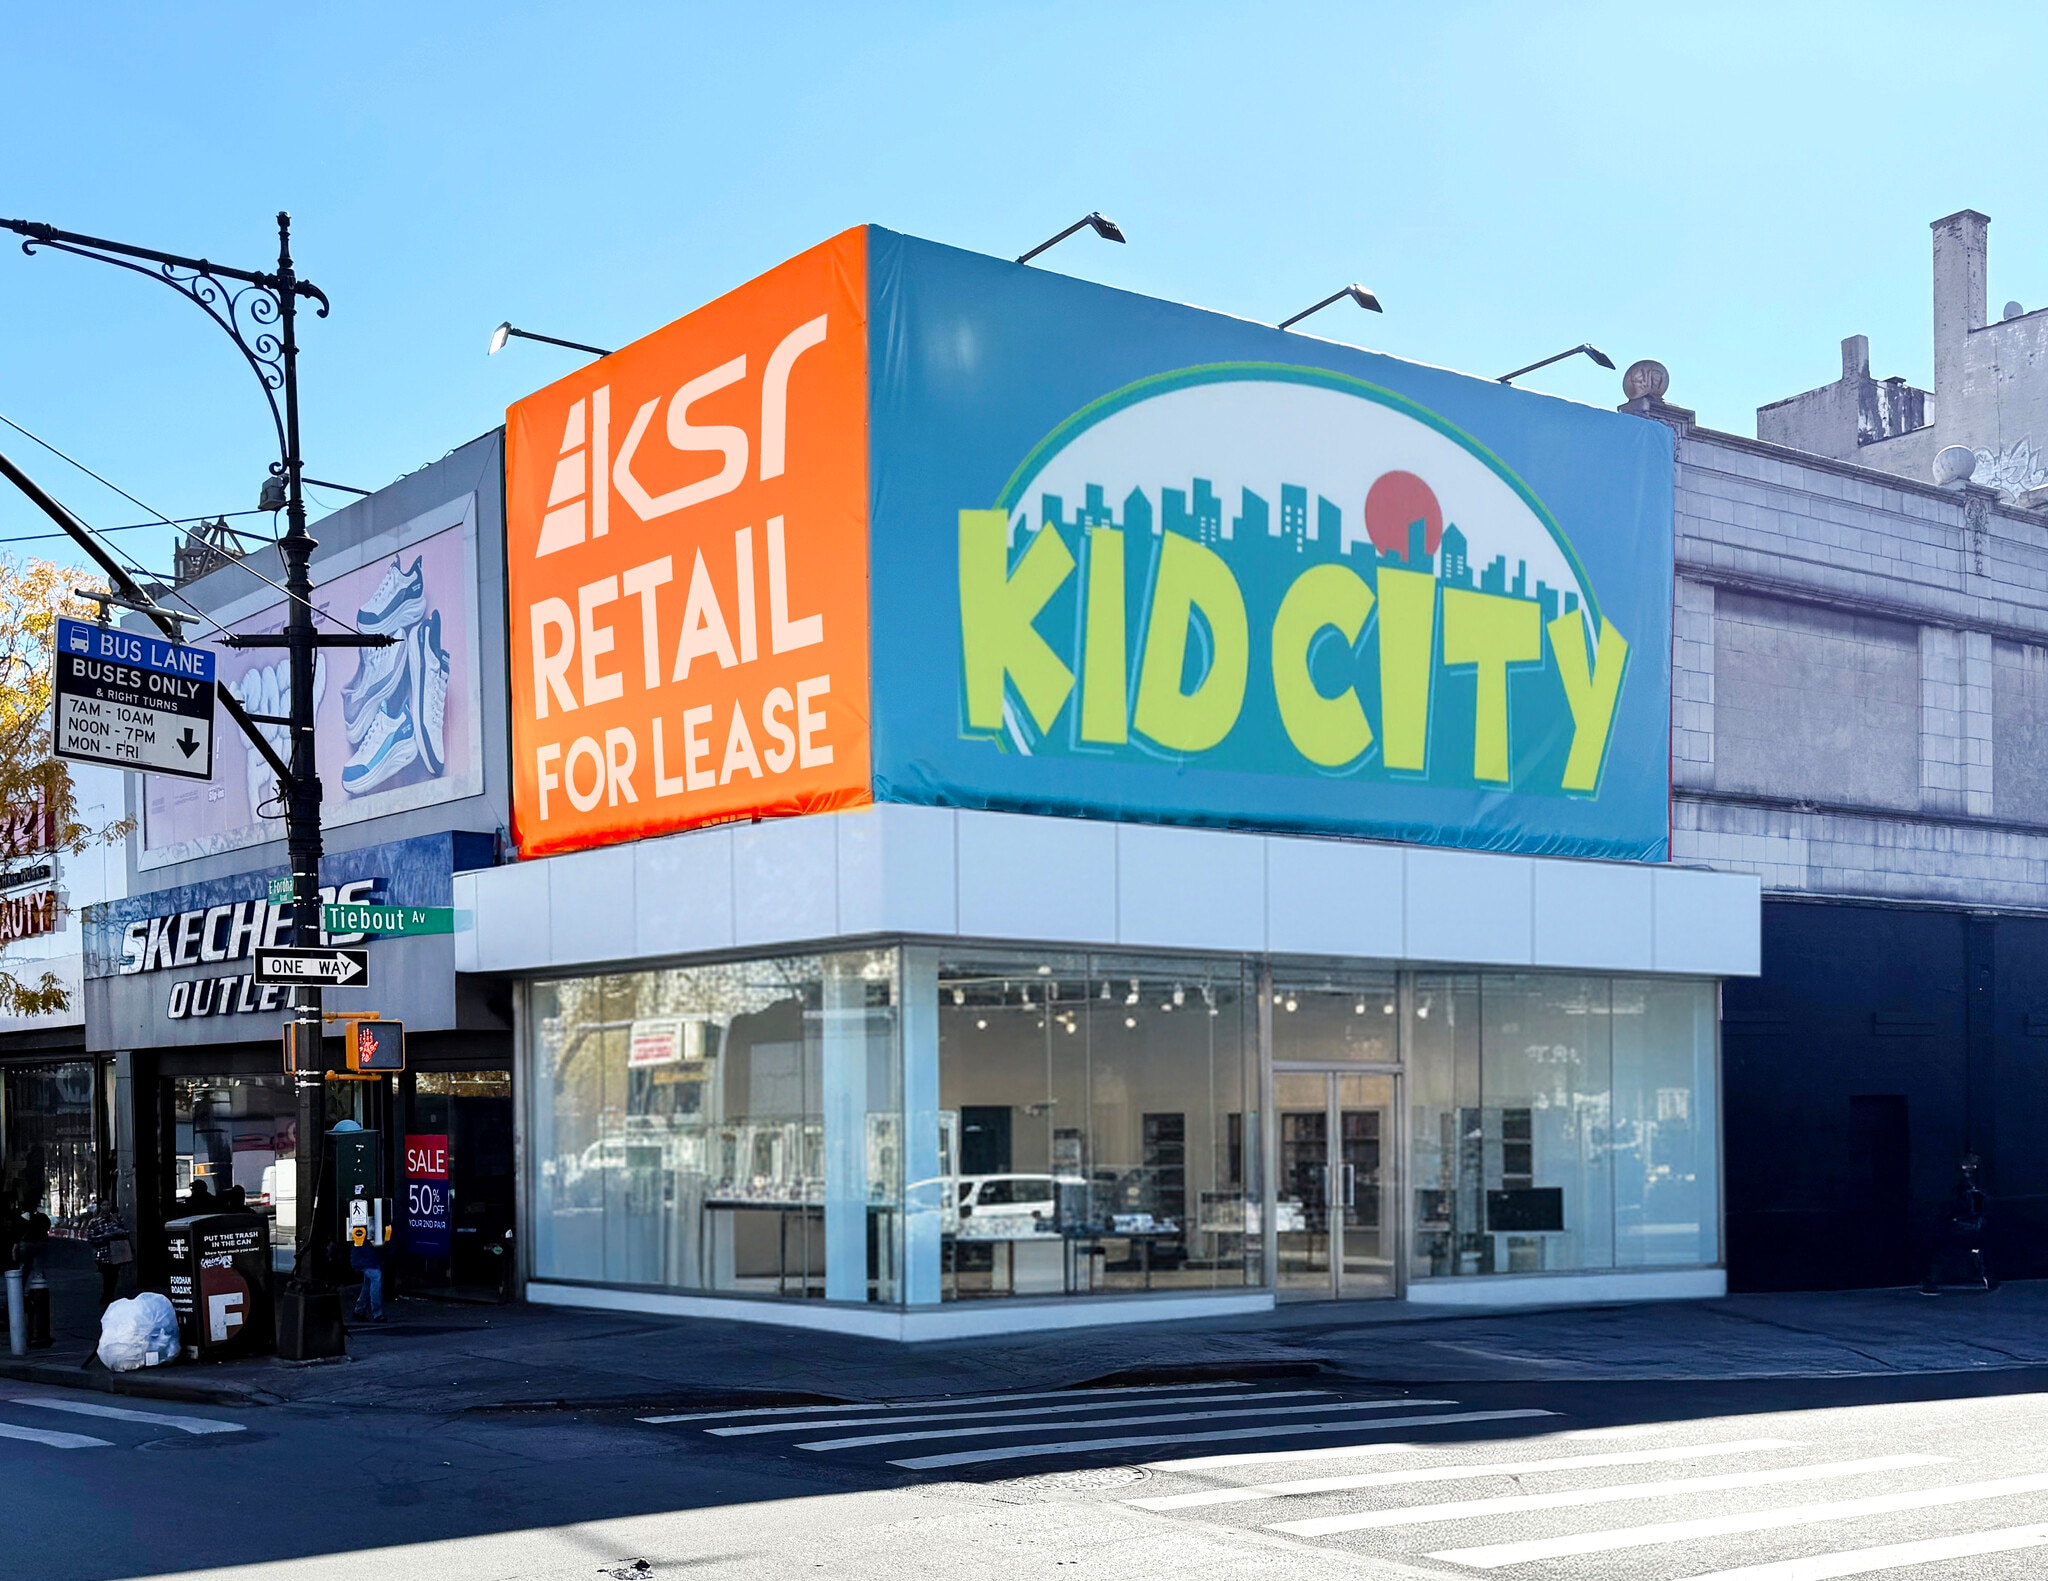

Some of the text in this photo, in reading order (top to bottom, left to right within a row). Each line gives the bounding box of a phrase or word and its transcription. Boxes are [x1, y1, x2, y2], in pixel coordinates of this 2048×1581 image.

[530, 515, 824, 720] RETAIL
[100, 634, 205, 676] BUS LANE
[957, 509, 1630, 795] KID CITY
[72, 658, 200, 700] BUSES ONLY
[70, 699, 100, 717] 7AM
[117, 708, 154, 726] 10AM
[96, 688, 178, 712] & RIGHT TURNS
[68, 717, 109, 736] NOON
[124, 727, 156, 744] 7PM
[68, 735, 100, 753] MON
[116, 743, 139, 759] FRI
[537, 674, 834, 821] FOR LEASE
[273, 877, 294, 894] Fordha
[119, 877, 376, 975] SKECHES
[329, 906, 426, 931] Tiebout Av
[271, 959, 351, 976] ONE WAY
[167, 974, 297, 1019] OUTLE
[408, 1149, 445, 1173] SALE
[432, 1205, 445, 1215] OFF
[235, 1231, 259, 1239] TRASH
[408, 1219, 422, 1227] YOUR
[423, 1220, 434, 1229] 2ND
[208, 1292, 244, 1341] F
